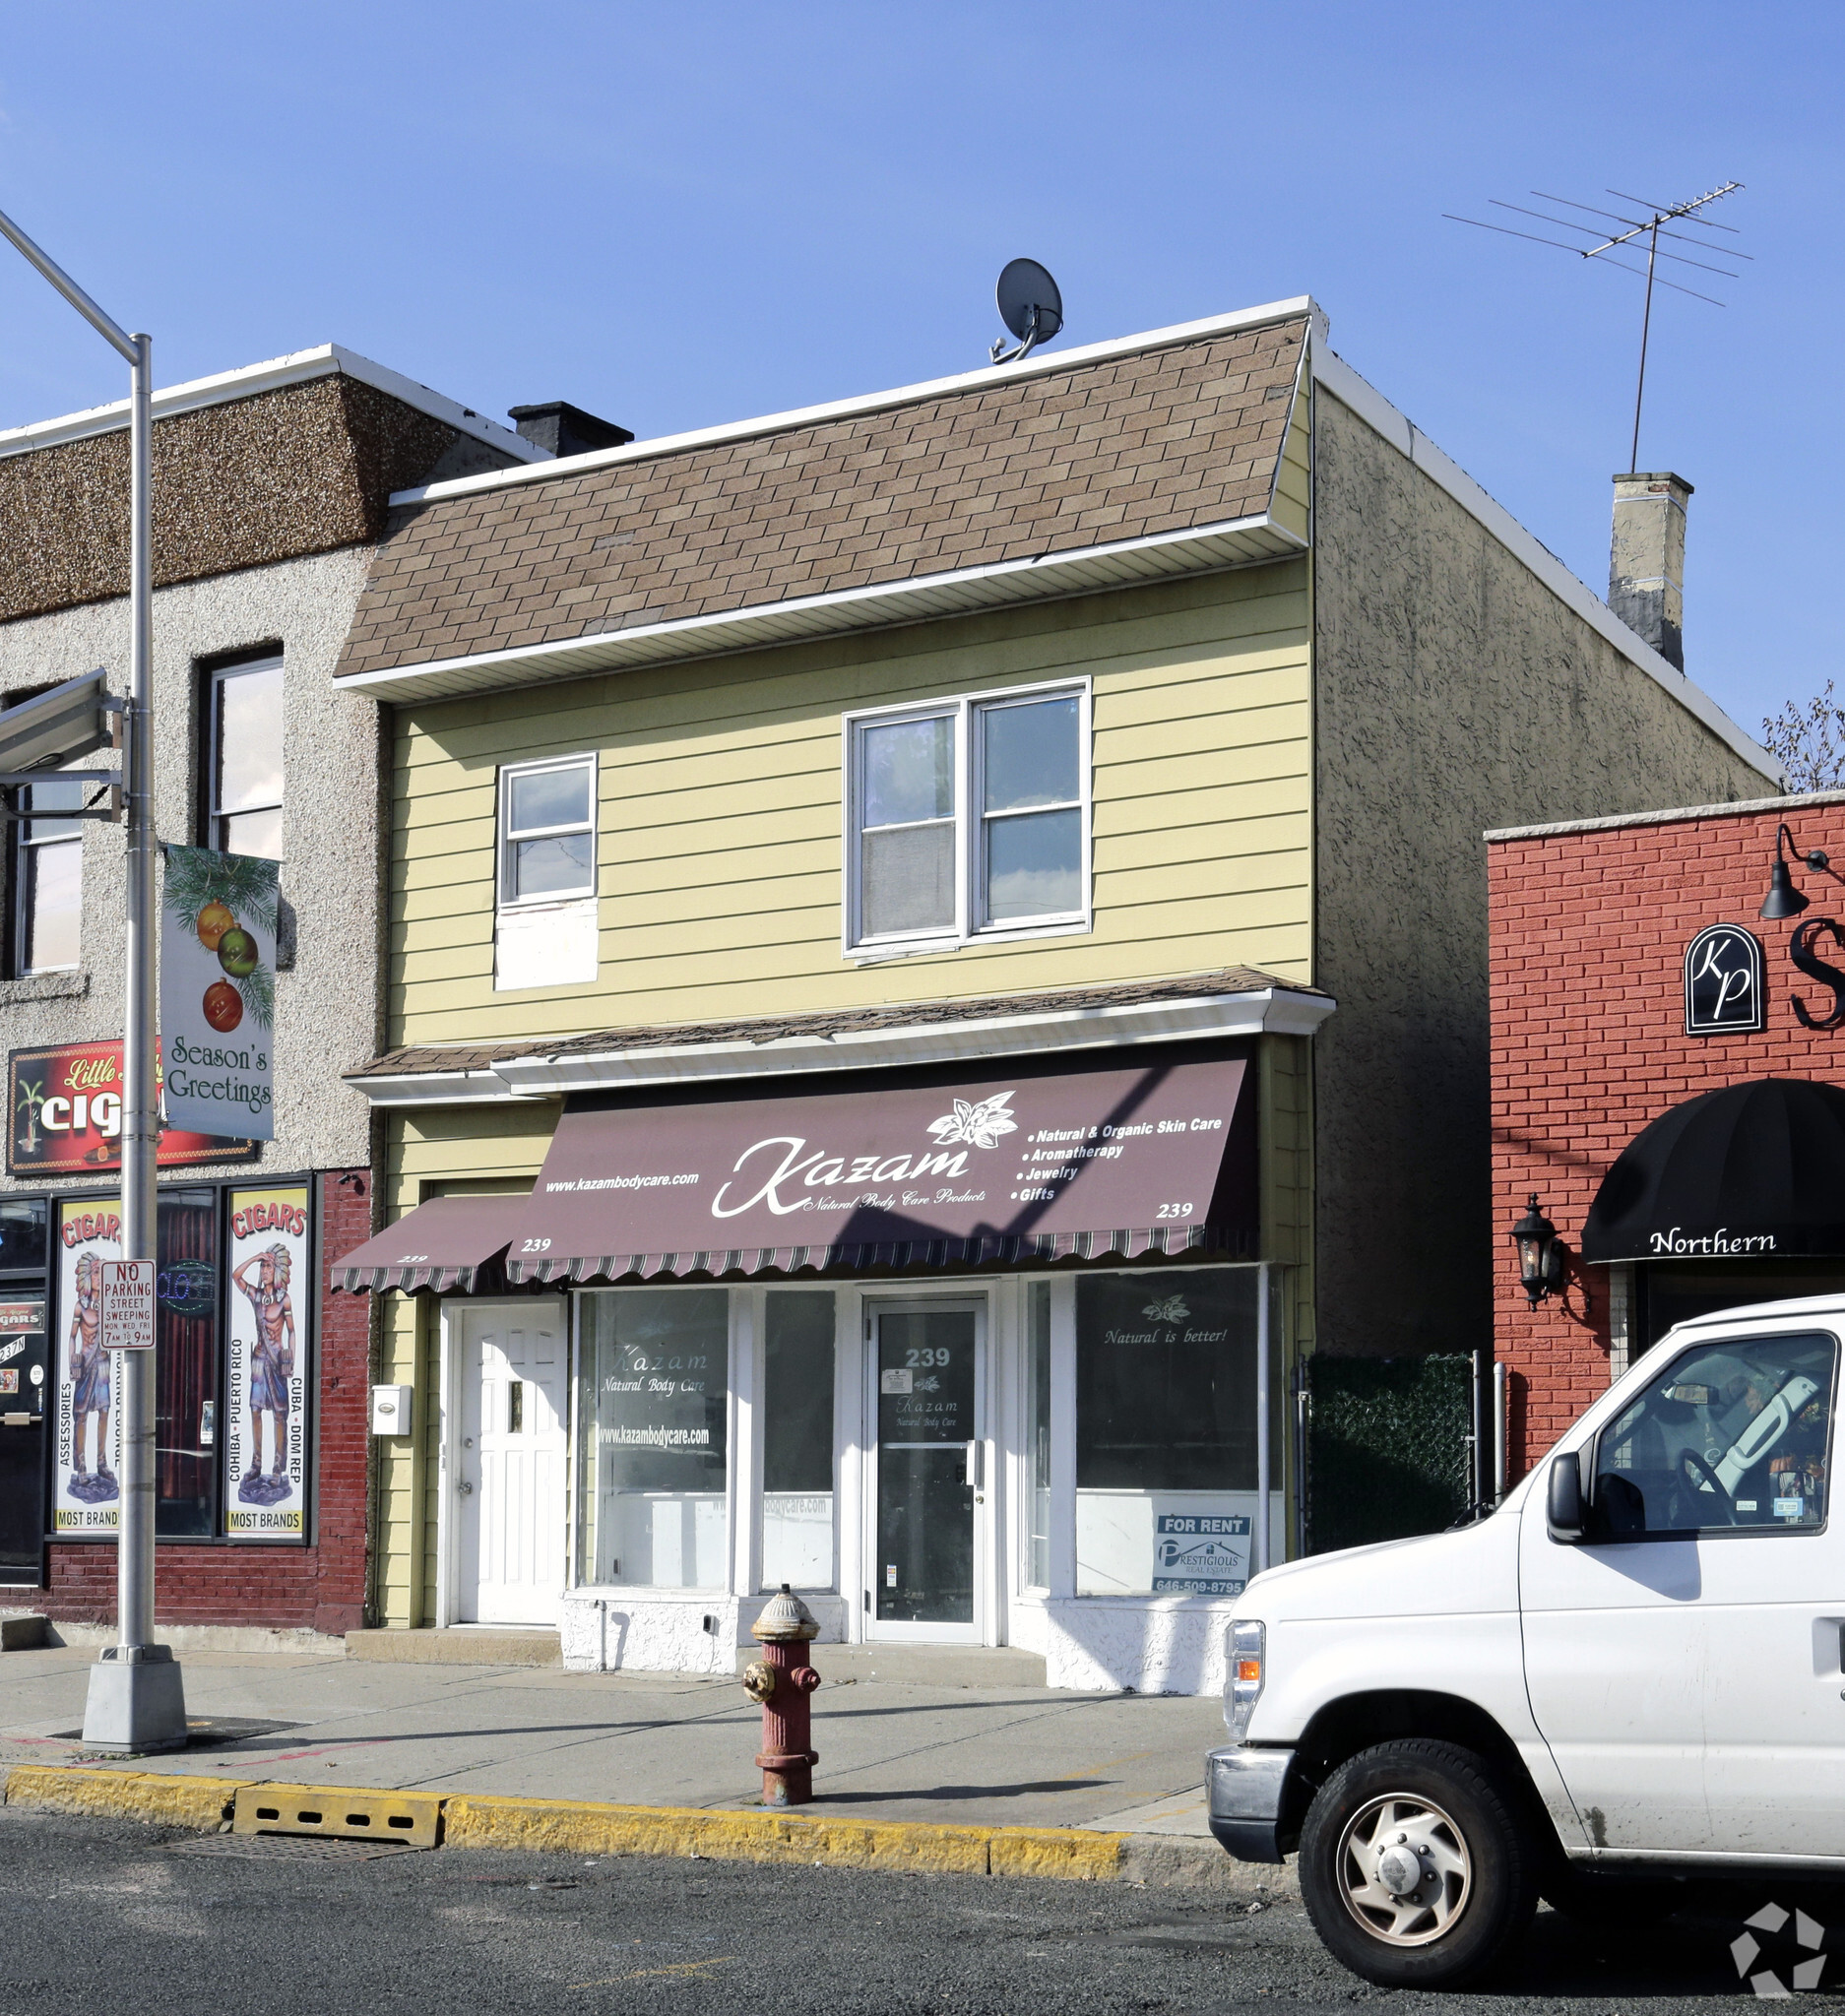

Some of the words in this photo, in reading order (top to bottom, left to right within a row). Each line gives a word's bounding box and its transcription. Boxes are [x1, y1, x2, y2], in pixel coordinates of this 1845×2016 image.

[171, 1036, 267, 1071] Season's
[64, 1055, 115, 1090] Little
[168, 1069, 271, 1114] Greetings
[1036, 1127, 1085, 1143] Natural
[1088, 1126, 1098, 1139] &
[1103, 1122, 1153, 1140] Organic
[1157, 1119, 1185, 1133] Skin
[1190, 1117, 1222, 1131] Care
[1031, 1144, 1123, 1162] Aromatherapy
[545, 1172, 700, 1193] www.kazambodycare.com
[711, 1136, 970, 1219] Kazam
[1026, 1166, 1078, 1181] Jewelry
[803, 1195, 861, 1212] Natural
[859, 1192, 895, 1212] Body
[901, 1190, 929, 1207] Care
[933, 1187, 986, 1205] Products
[1019, 1187, 1055, 1202] Gifts
[230, 1202, 306, 1239] CIGARS
[1156, 1202, 1193, 1219] 239
[521, 1237, 551, 1253] 239
[1649, 1227, 1776, 1254] Northern
[116, 1263, 139, 1281] NO
[105, 1284, 151, 1296] PARKING
[110, 1298, 144, 1308] STREET
[106, 1311, 150, 1320] SWEEPING
[1104, 1328, 1161, 1344] Natural
[1165, 1330, 1177, 1343] is
[1183, 1327, 1228, 1343] better!
[231, 1339, 242, 1369] RICO
[906, 1348, 950, 1367] 239
[291, 1377, 302, 1413] CUBA
[601, 1375, 645, 1392] Natural
[648, 1377, 675, 1398] Body
[680, 1378, 705, 1392] Care
[231, 1373, 242, 1423] PUERTO
[896, 1395, 958, 1414] Kazam
[60, 1383, 71, 1466] ASSESSORIES
[290, 1425, 301, 1453] DOM
[229, 1433, 241, 1482] COHIBA
[290, 1455, 301, 1483] REP
[58, 1512, 83, 1526] MOST
[87, 1511, 119, 1525] BRAND
[230, 1513, 258, 1528] MOST
[260, 1513, 299, 1528] BRANDS
[1165, 1518, 1195, 1532] FOR
[1200, 1519, 1242, 1533] RENT
[1156, 1580, 1241, 1594] 646-509-8795
